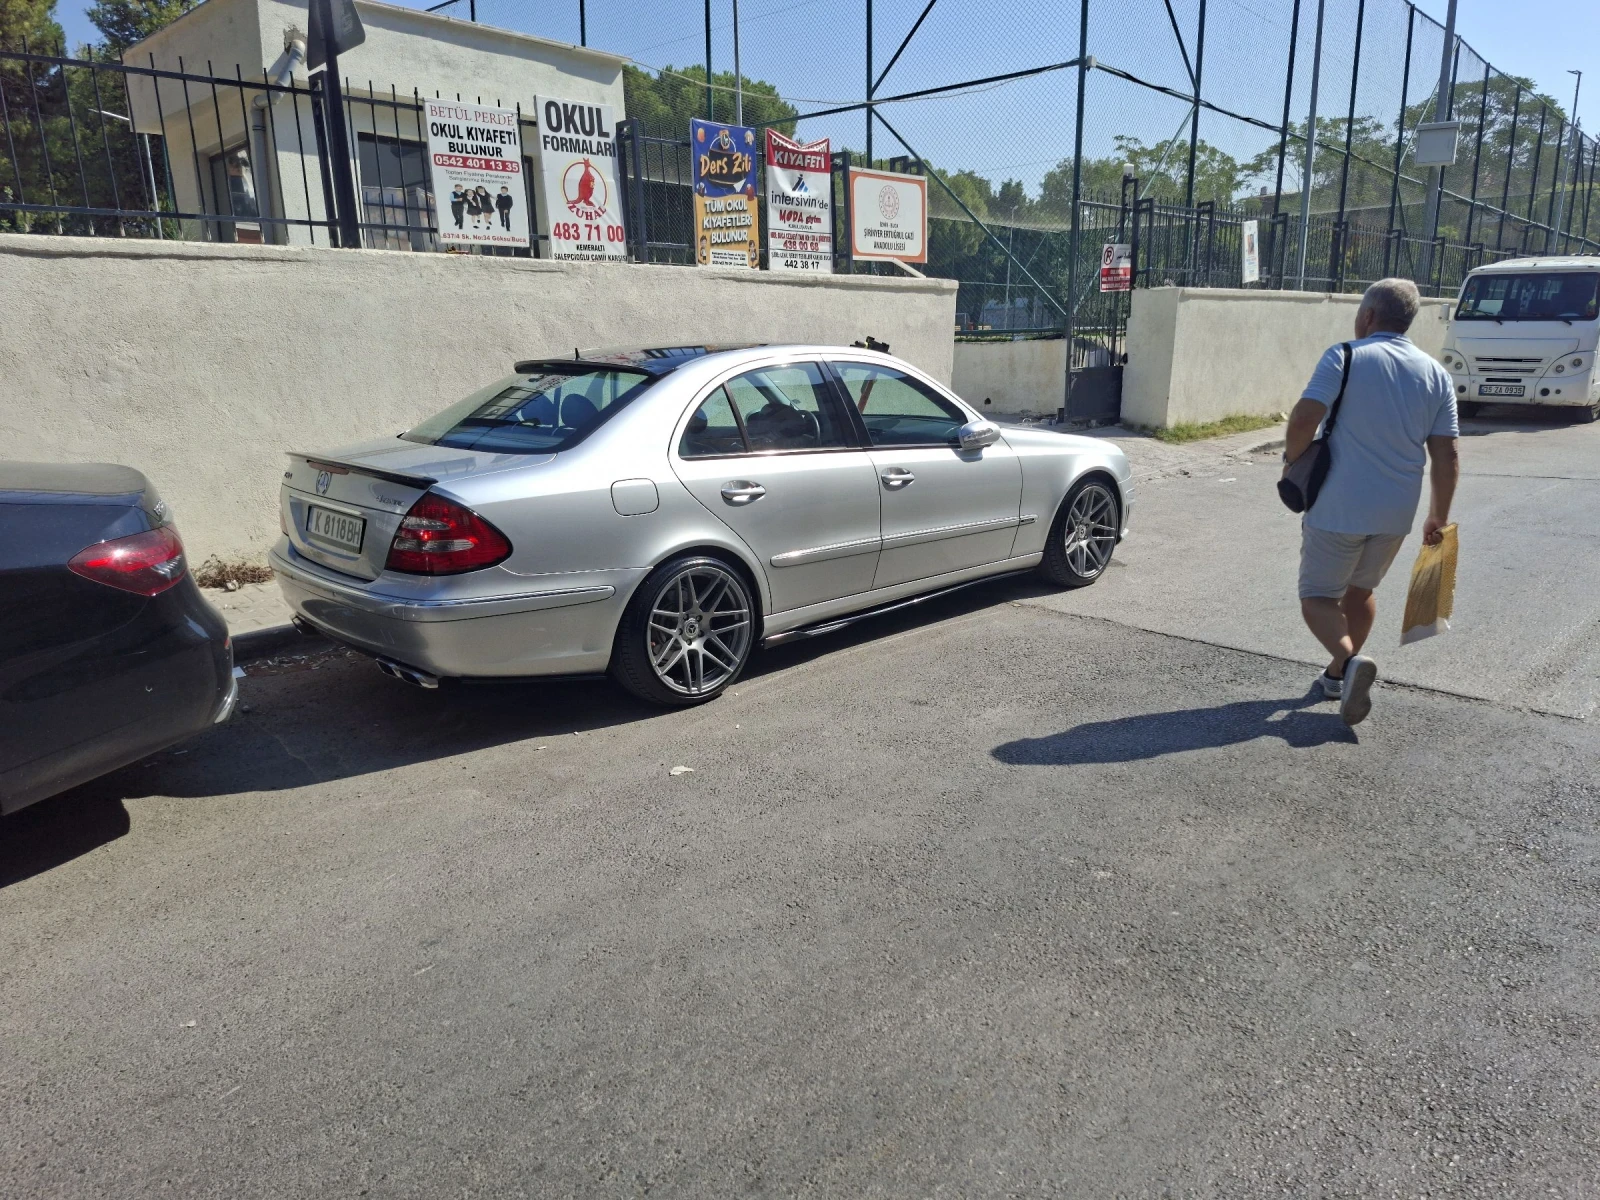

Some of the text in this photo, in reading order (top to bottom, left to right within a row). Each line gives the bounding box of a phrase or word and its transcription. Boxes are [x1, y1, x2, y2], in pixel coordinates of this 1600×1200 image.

[429, 104, 515, 127] BETÜL PERDE
[545, 100, 610, 138] OKUL
[430, 121, 517, 146] OKUL KIYAFETİ
[448, 141, 503, 158] BULUNUR
[542, 134, 617, 158] FORMALARI
[435, 155, 519, 172] 0542 401 13 35
[700, 154, 728, 177] Ders
[774, 150, 825, 169] KIYAFETİ
[567, 203, 607, 221] ZUHAL
[726, 198, 748, 212] OKUL
[703, 213, 753, 230] KIYAFETLERİ
[779, 209, 804, 224] MODA
[553, 222, 625, 243] 483 71 00
[711, 230, 748, 244] BULUNUR
[576, 244, 606, 252] KEMERALTI
[783, 239, 797, 250] 438
[873, 240, 906, 252] ANADOLU LİSESİ
[784, 259, 820, 270] 442 38 17
[1494, 386, 1502, 394] ZA
[1504, 386, 1523, 394] 0935
[314, 511, 323, 533] K
